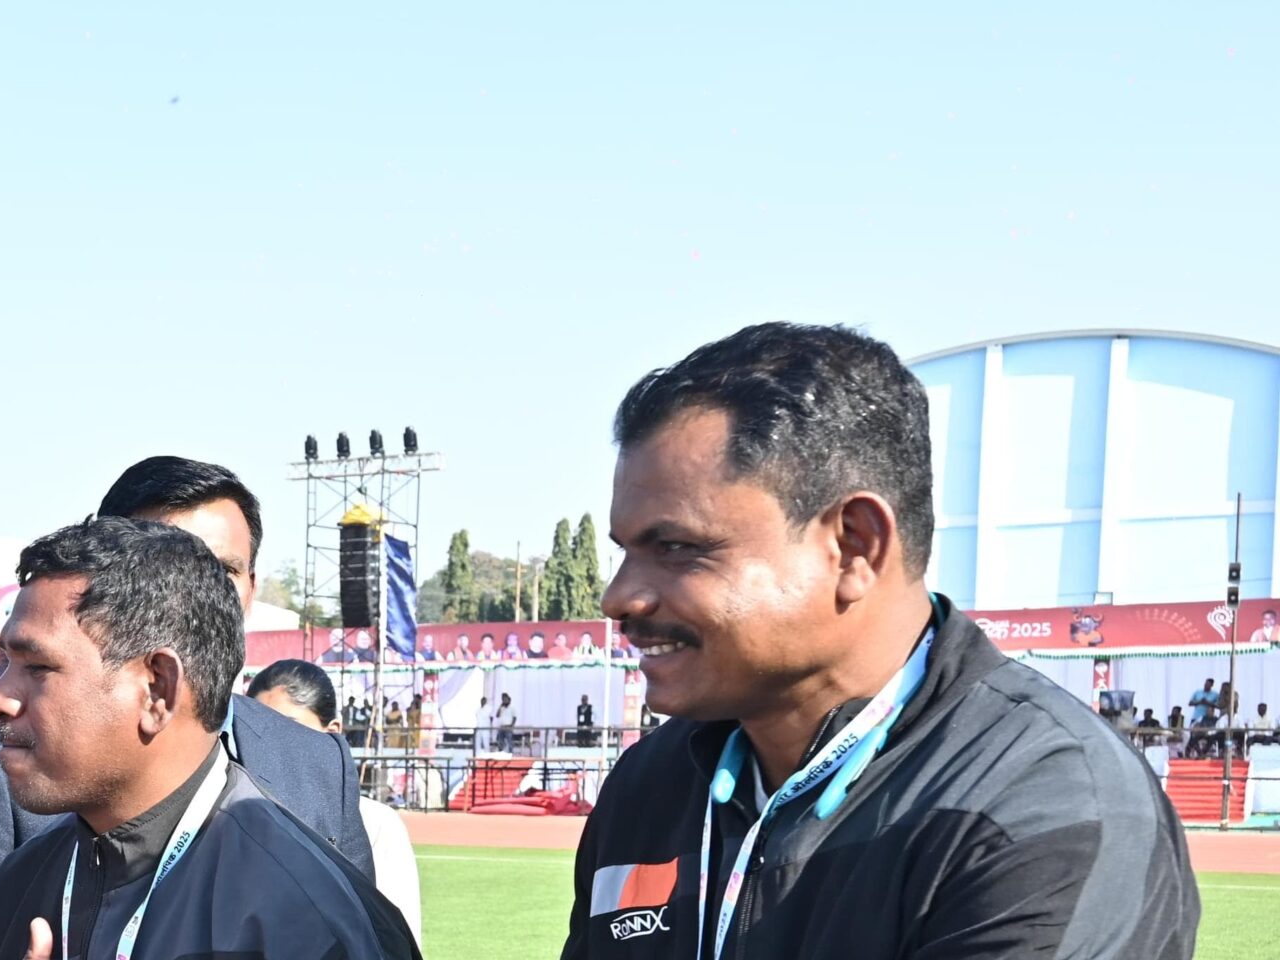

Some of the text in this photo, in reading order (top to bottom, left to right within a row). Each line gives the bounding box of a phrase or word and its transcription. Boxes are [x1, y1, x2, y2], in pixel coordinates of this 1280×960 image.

[1010, 622, 1052, 638] 2025
[832, 733, 859, 760] 2025
[174, 831, 191, 853] 2025
